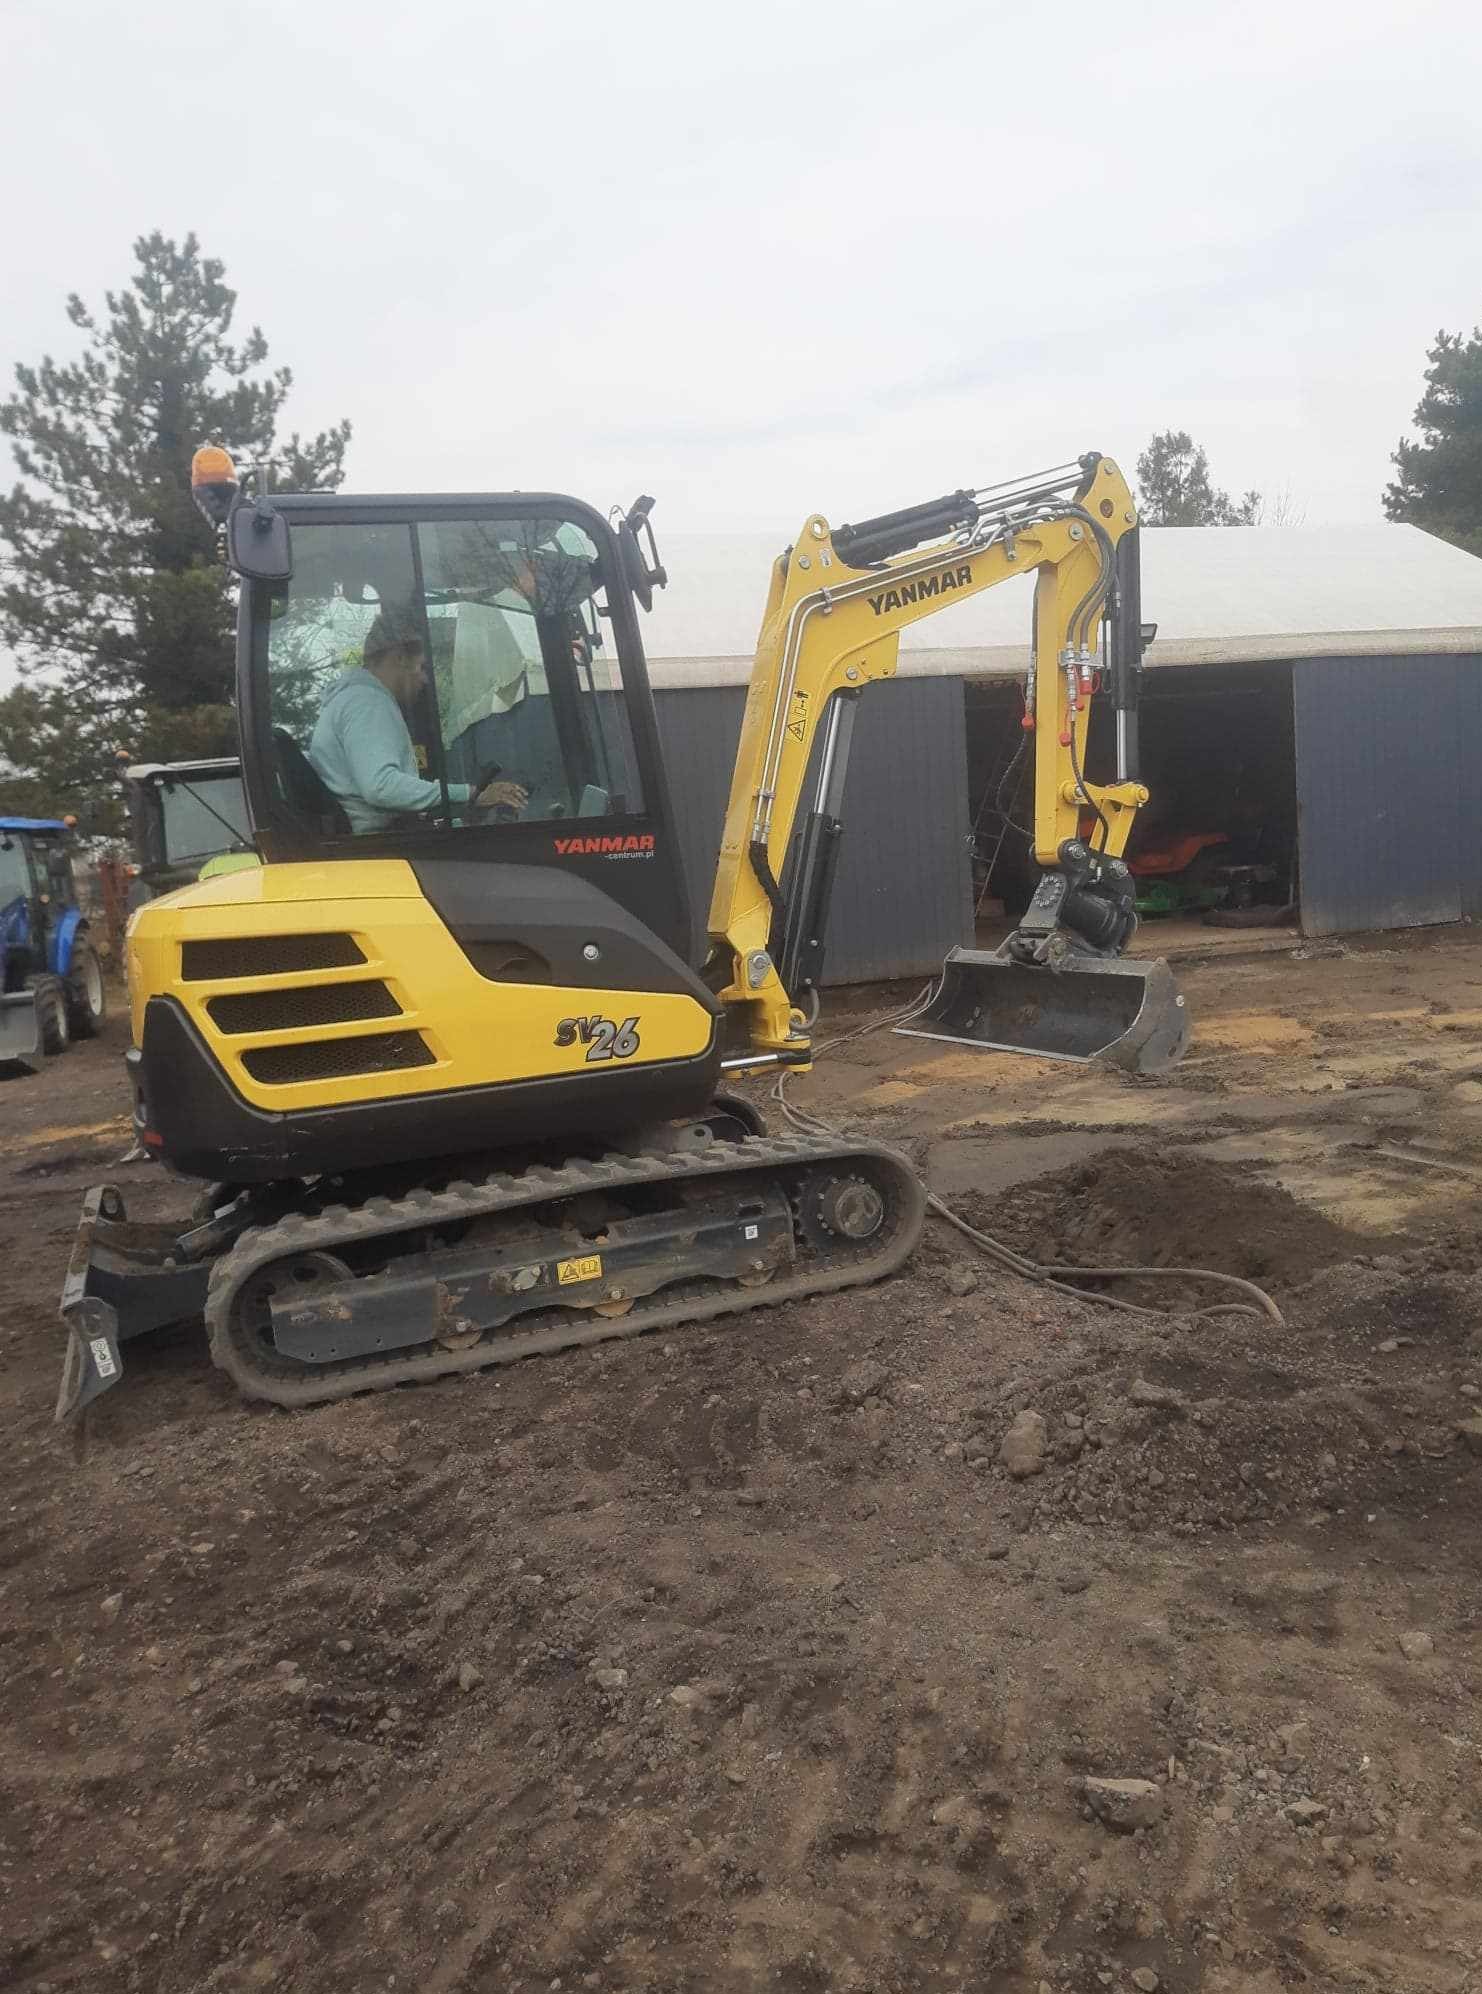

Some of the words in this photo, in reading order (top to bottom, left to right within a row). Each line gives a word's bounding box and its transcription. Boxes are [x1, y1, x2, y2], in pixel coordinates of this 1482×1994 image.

[867, 565, 972, 616] YANMAR
[554, 835, 655, 854] YANMAR
[553, 1015, 641, 1062] SV26
